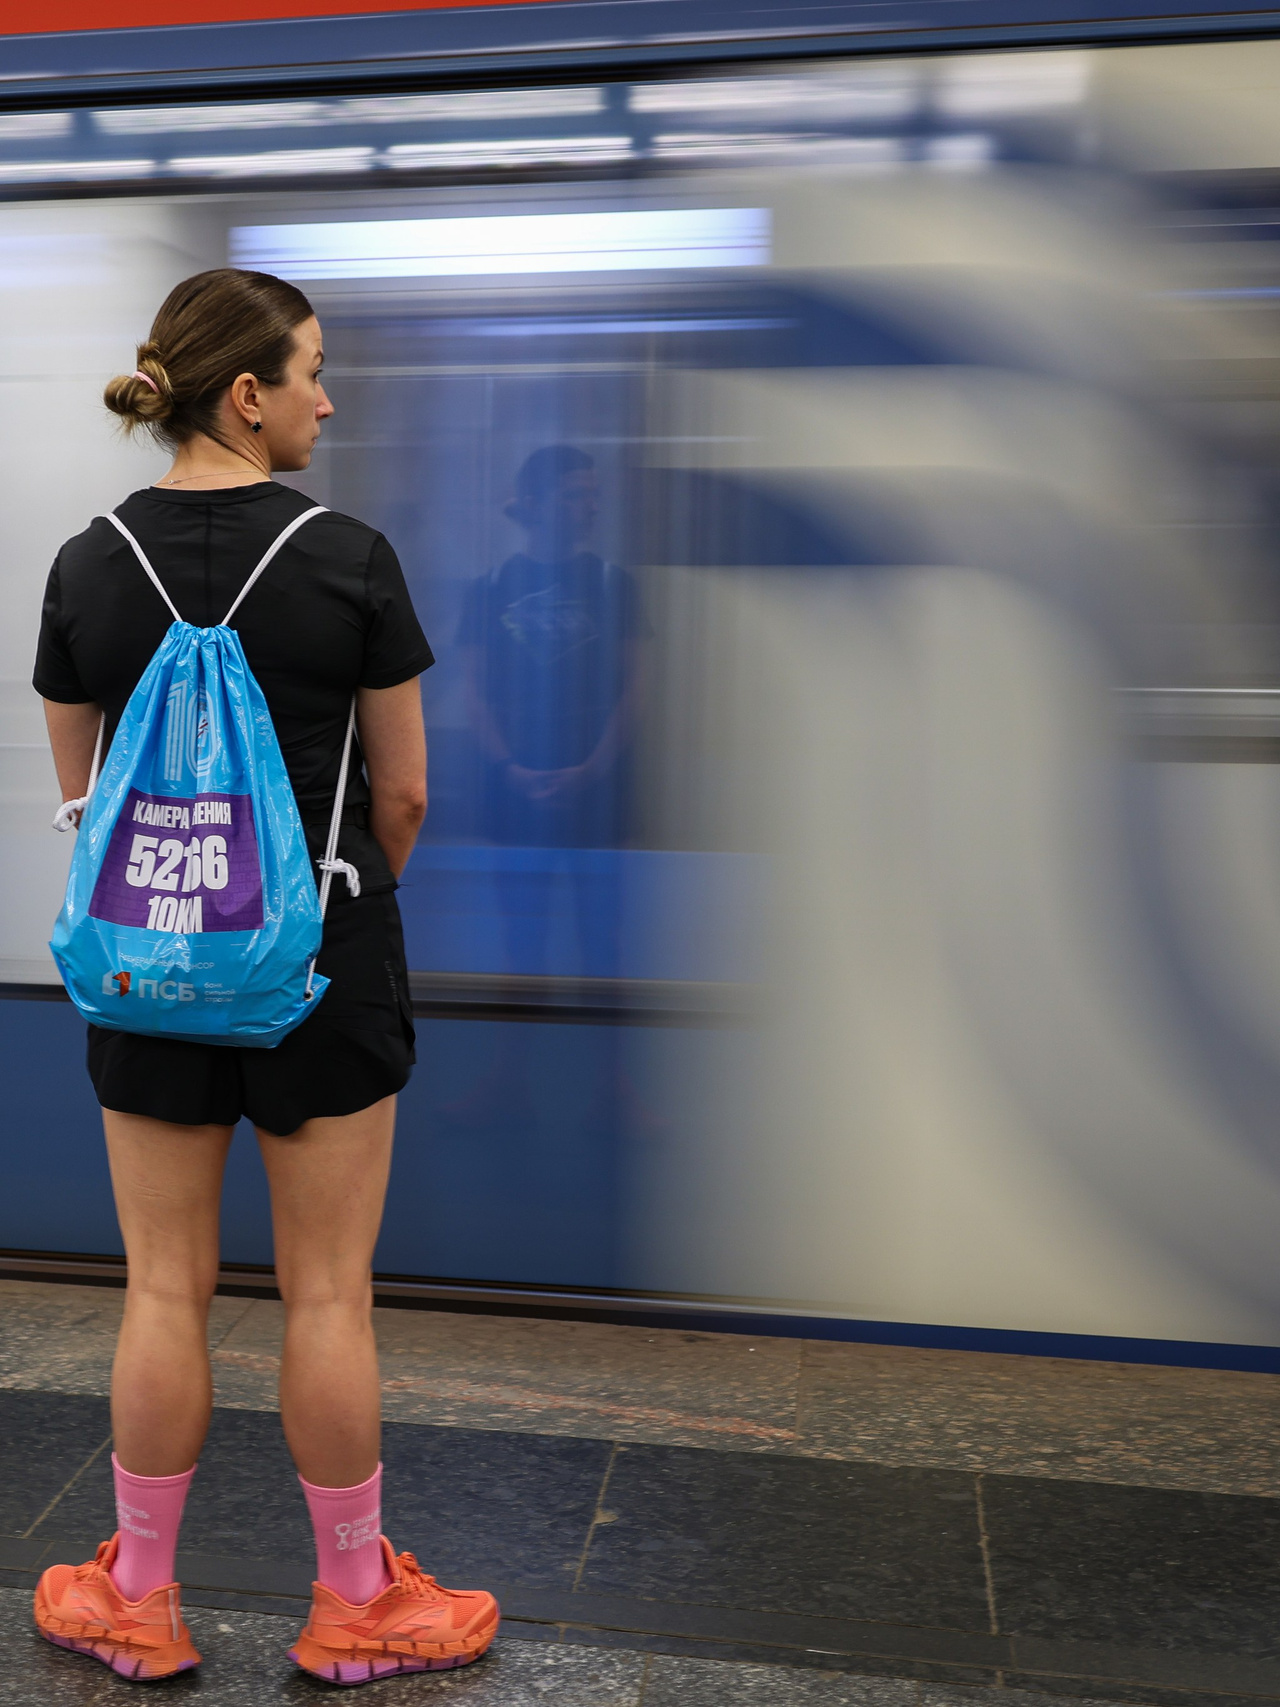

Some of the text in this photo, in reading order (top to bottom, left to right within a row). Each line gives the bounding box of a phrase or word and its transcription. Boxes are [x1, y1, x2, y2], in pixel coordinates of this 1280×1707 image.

[132, 800, 190, 830] КАМЕРА
[138, 978, 196, 1002] ПСБ
[203, 981, 223, 989] банк
